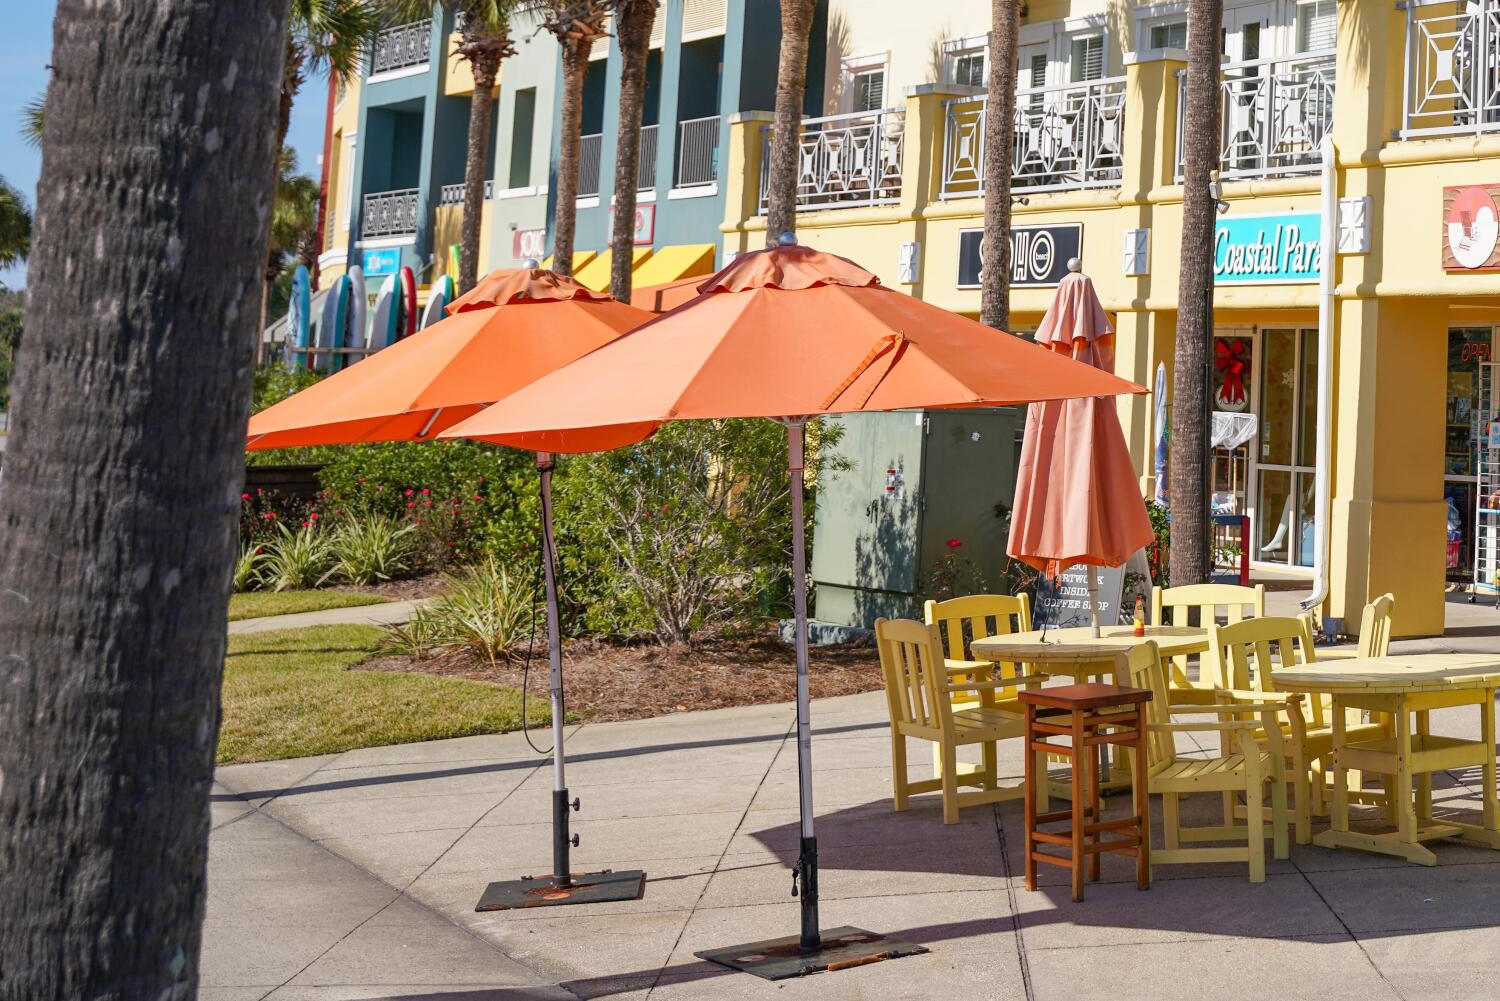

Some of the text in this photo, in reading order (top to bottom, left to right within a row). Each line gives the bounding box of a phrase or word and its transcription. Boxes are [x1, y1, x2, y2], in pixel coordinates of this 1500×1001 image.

[1213, 223, 1282, 275] Coastal
[1060, 587, 1089, 596] INSID
[1044, 598, 1080, 608] COFFEE
